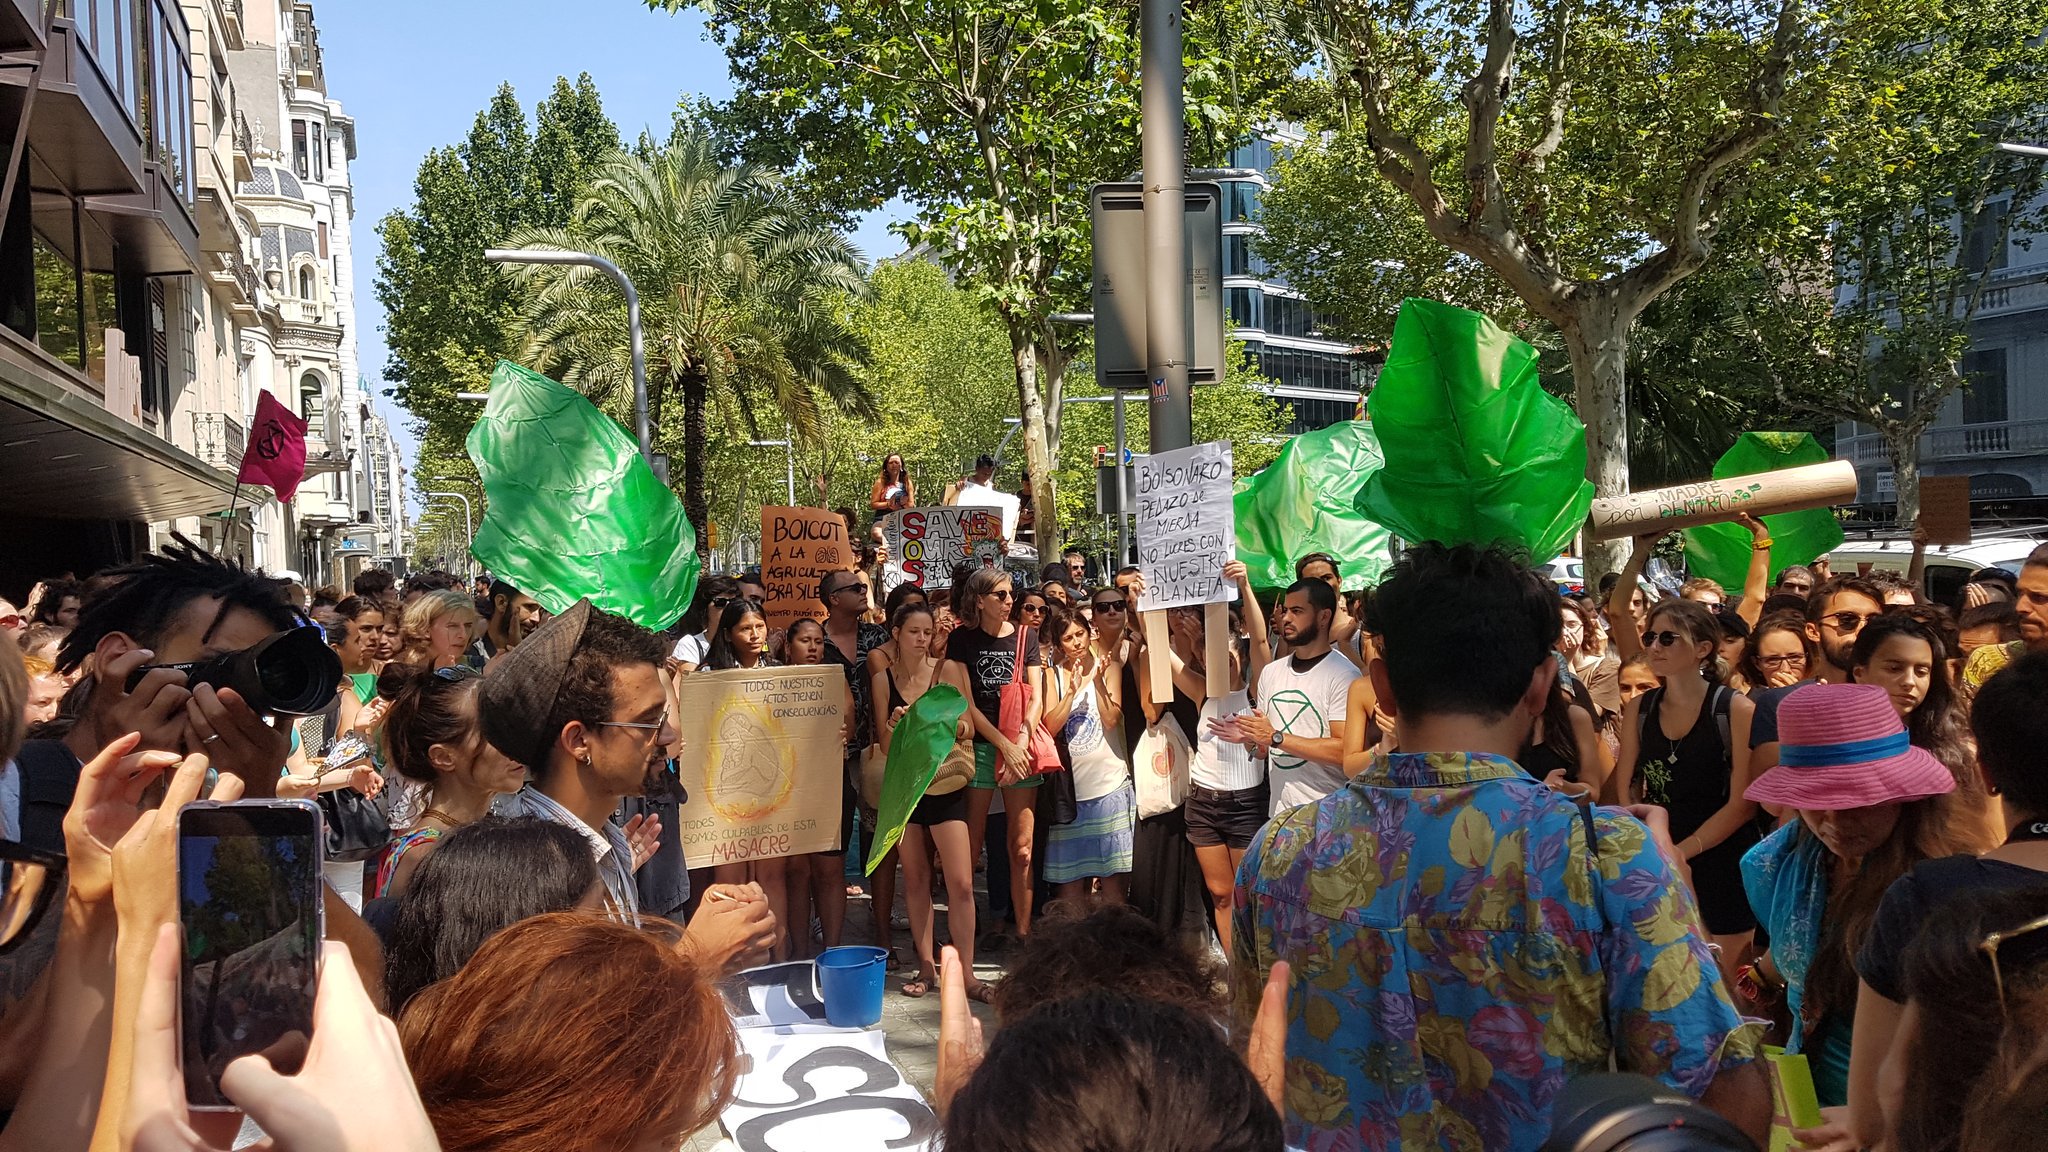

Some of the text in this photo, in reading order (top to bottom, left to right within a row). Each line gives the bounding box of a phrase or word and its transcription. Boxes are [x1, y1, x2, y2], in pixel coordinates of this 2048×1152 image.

[1659, 480, 1722, 501] MADRE
[1140, 492, 1188, 524] PEDAZO
[1658, 493, 1731, 519] DENTRO
[773, 517, 842, 543] BOICOT
[901, 509, 989, 540] SAVE
[1156, 511, 1199, 537] MIERDA
[770, 546, 805, 562] A LA
[903, 539, 970, 561] OUR
[1140, 548, 1158, 564] NO
[1200, 528, 1225, 549] CON
[766, 565, 830, 582] AGRICULT
[1153, 551, 1229, 584] NUESTRO
[766, 582, 820, 602] BRASILE
[1149, 577, 1223, 603] PLANETA
[741, 680, 775, 693] TODOS
[762, 694, 788, 705] ACTOS
[683, 832, 718, 845] SOMOS
[794, 819, 817, 831] ESTA
